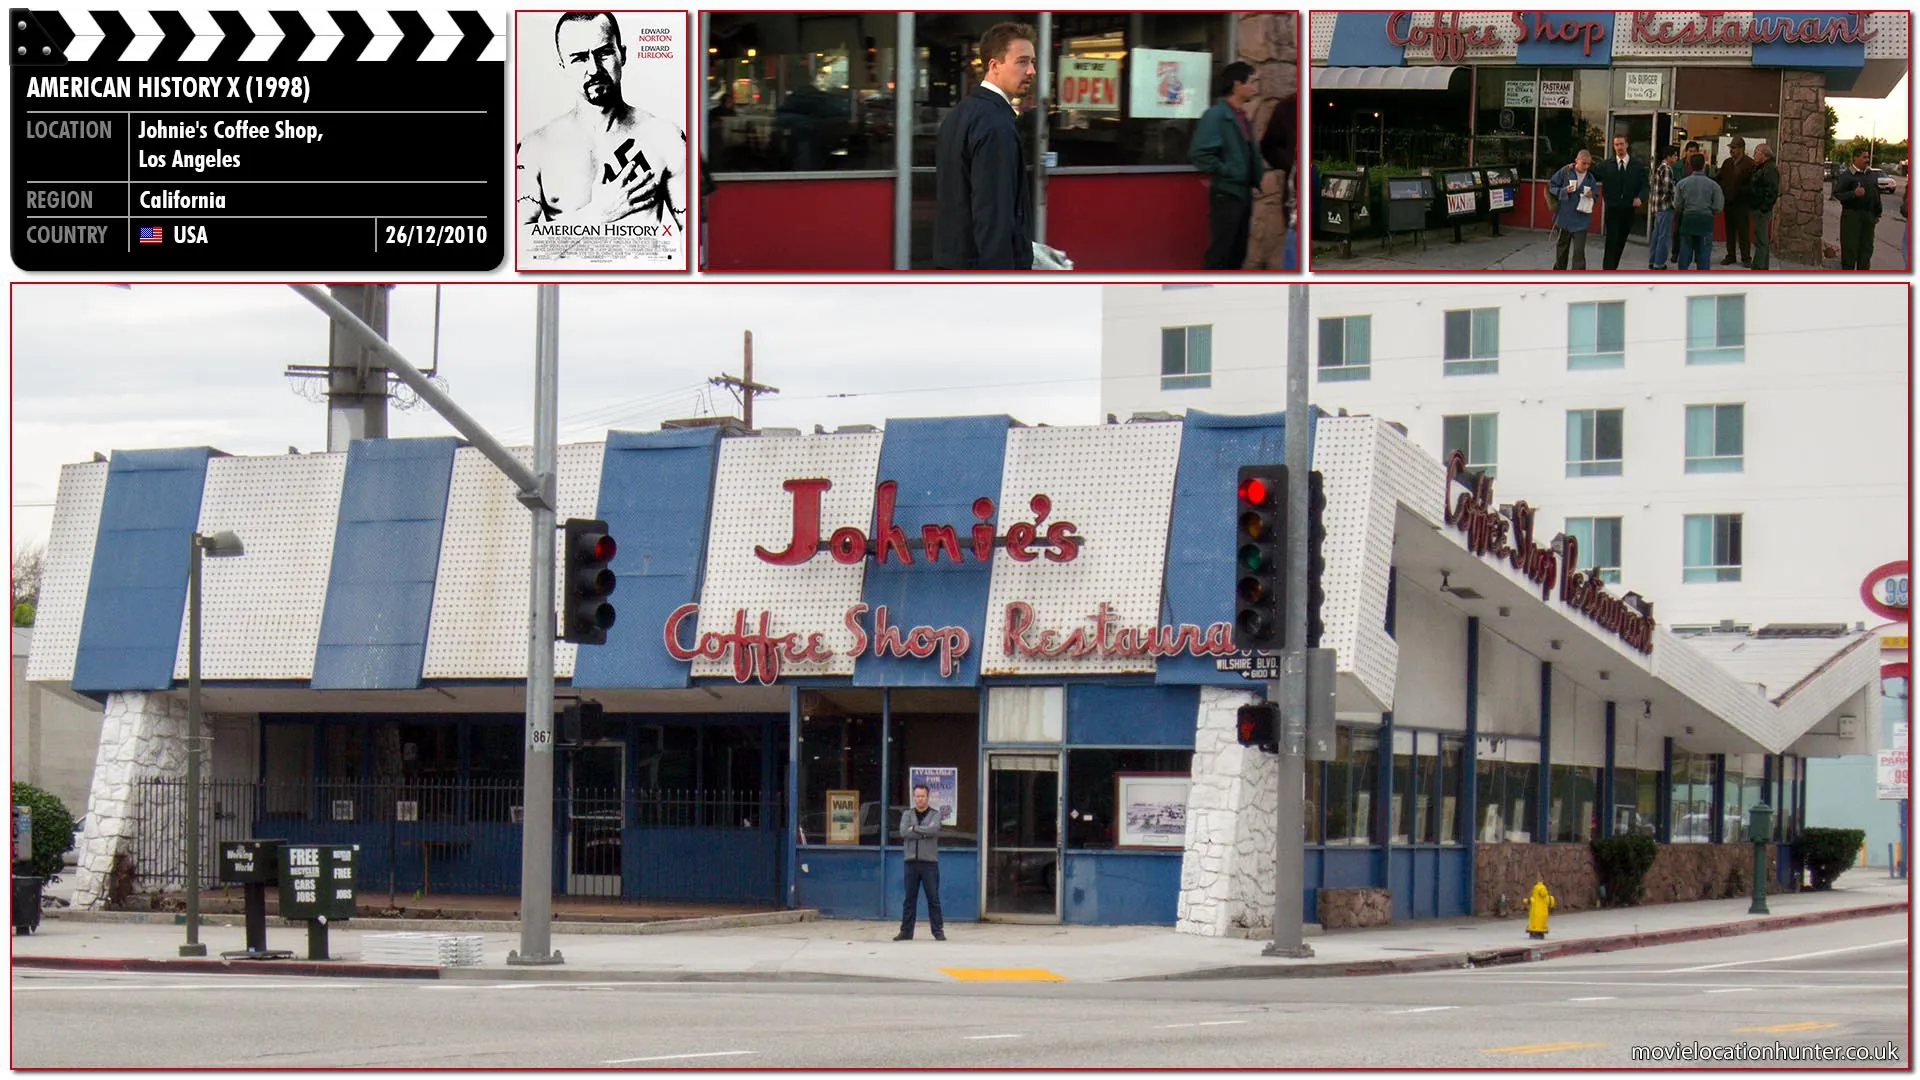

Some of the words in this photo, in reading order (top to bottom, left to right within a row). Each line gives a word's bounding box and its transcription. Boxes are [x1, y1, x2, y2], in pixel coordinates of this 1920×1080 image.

[1386, 12, 1504, 62] Coffee
[1511, 12, 1606, 56] Shop
[1631, 12, 1879, 46] Restaurant
[1073, 62, 1106, 71] WE'RE
[1062, 76, 1115, 105] OPEN
[1542, 82, 1571, 91] PASTRAMI
[1327, 211, 1343, 222] LA
[531, 224, 601, 236] AMERICAN
[604, 224, 659, 236] HISTORY
[661, 224, 673, 237] X
[754, 478, 1082, 566] Johnie's
[663, 602, 833, 685] Coffee
[844, 601, 971, 677] Shop
[1002, 600, 1270, 658] Restaura
[1216, 658, 1252, 670] WILSHIRE
[1257, 658, 1279, 669] BLVD.
[1251, 669, 1268, 678] 6100
[533, 730, 551, 743] 867
[832, 800, 854, 810] WAR
[226, 849, 253, 861] Working
[290, 848, 319, 866] FREE
[235, 862, 254, 872] World
[333, 867, 352, 879] FREE
[294, 879, 316, 890] CARS
[296, 891, 316, 903] JOBS
[335, 889, 352, 900] JOBS
